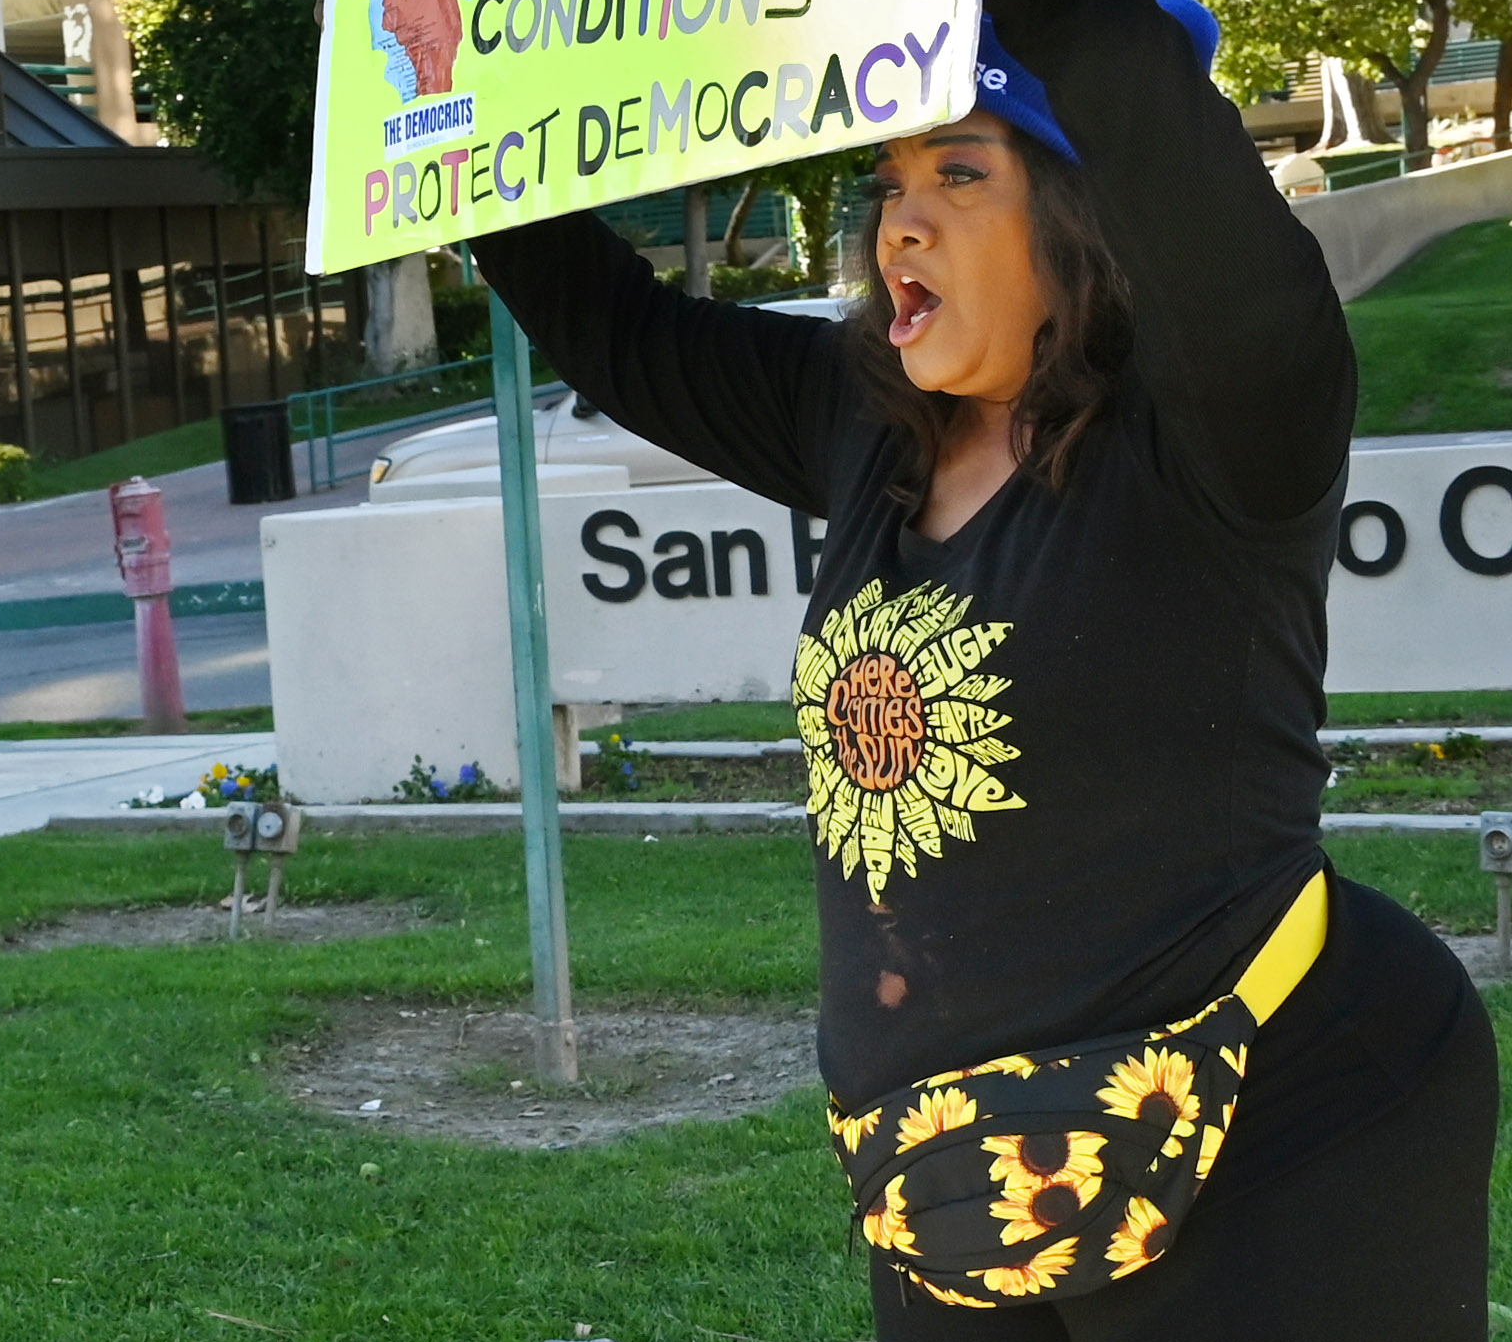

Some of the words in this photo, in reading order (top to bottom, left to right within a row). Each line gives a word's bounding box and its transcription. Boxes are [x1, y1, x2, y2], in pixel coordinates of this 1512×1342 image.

[364, 109, 562, 237] PROTECT
[576, 21, 952, 177] DEMOCRACY
[383, 116, 402, 148] THE
[405, 96, 474, 141] DEMOCRATS
[579, 509, 768, 604] San
